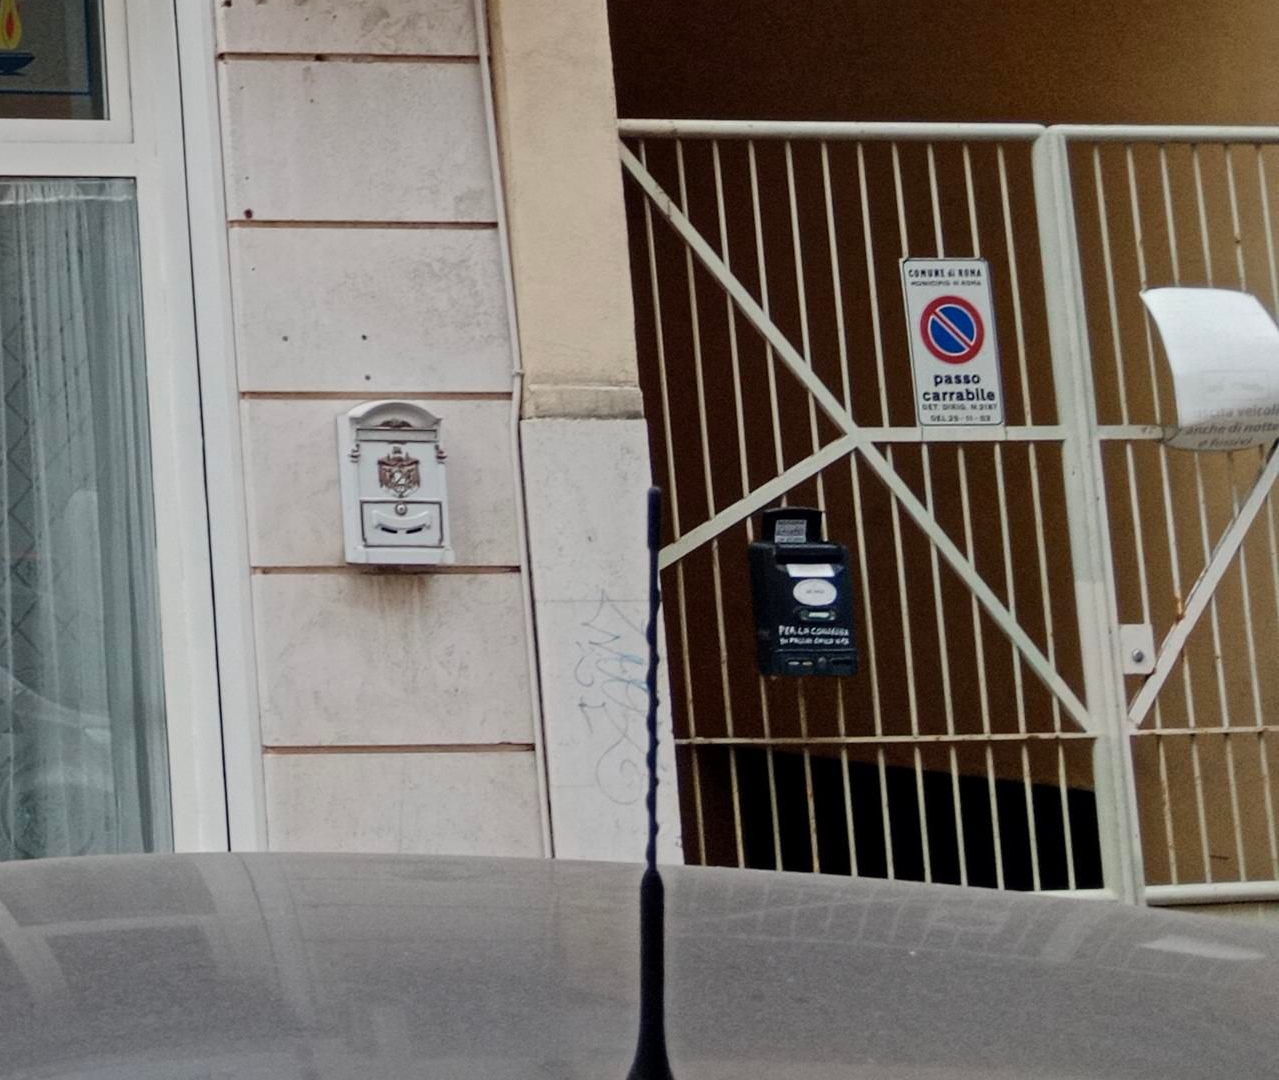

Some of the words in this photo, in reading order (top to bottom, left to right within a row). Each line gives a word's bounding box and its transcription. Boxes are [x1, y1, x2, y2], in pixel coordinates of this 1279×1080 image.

[908, 269, 945, 278] COMUNE
[958, 269, 982, 278] ROMA
[933, 374, 981, 386] passo
[922, 388, 996, 402] carrabile
